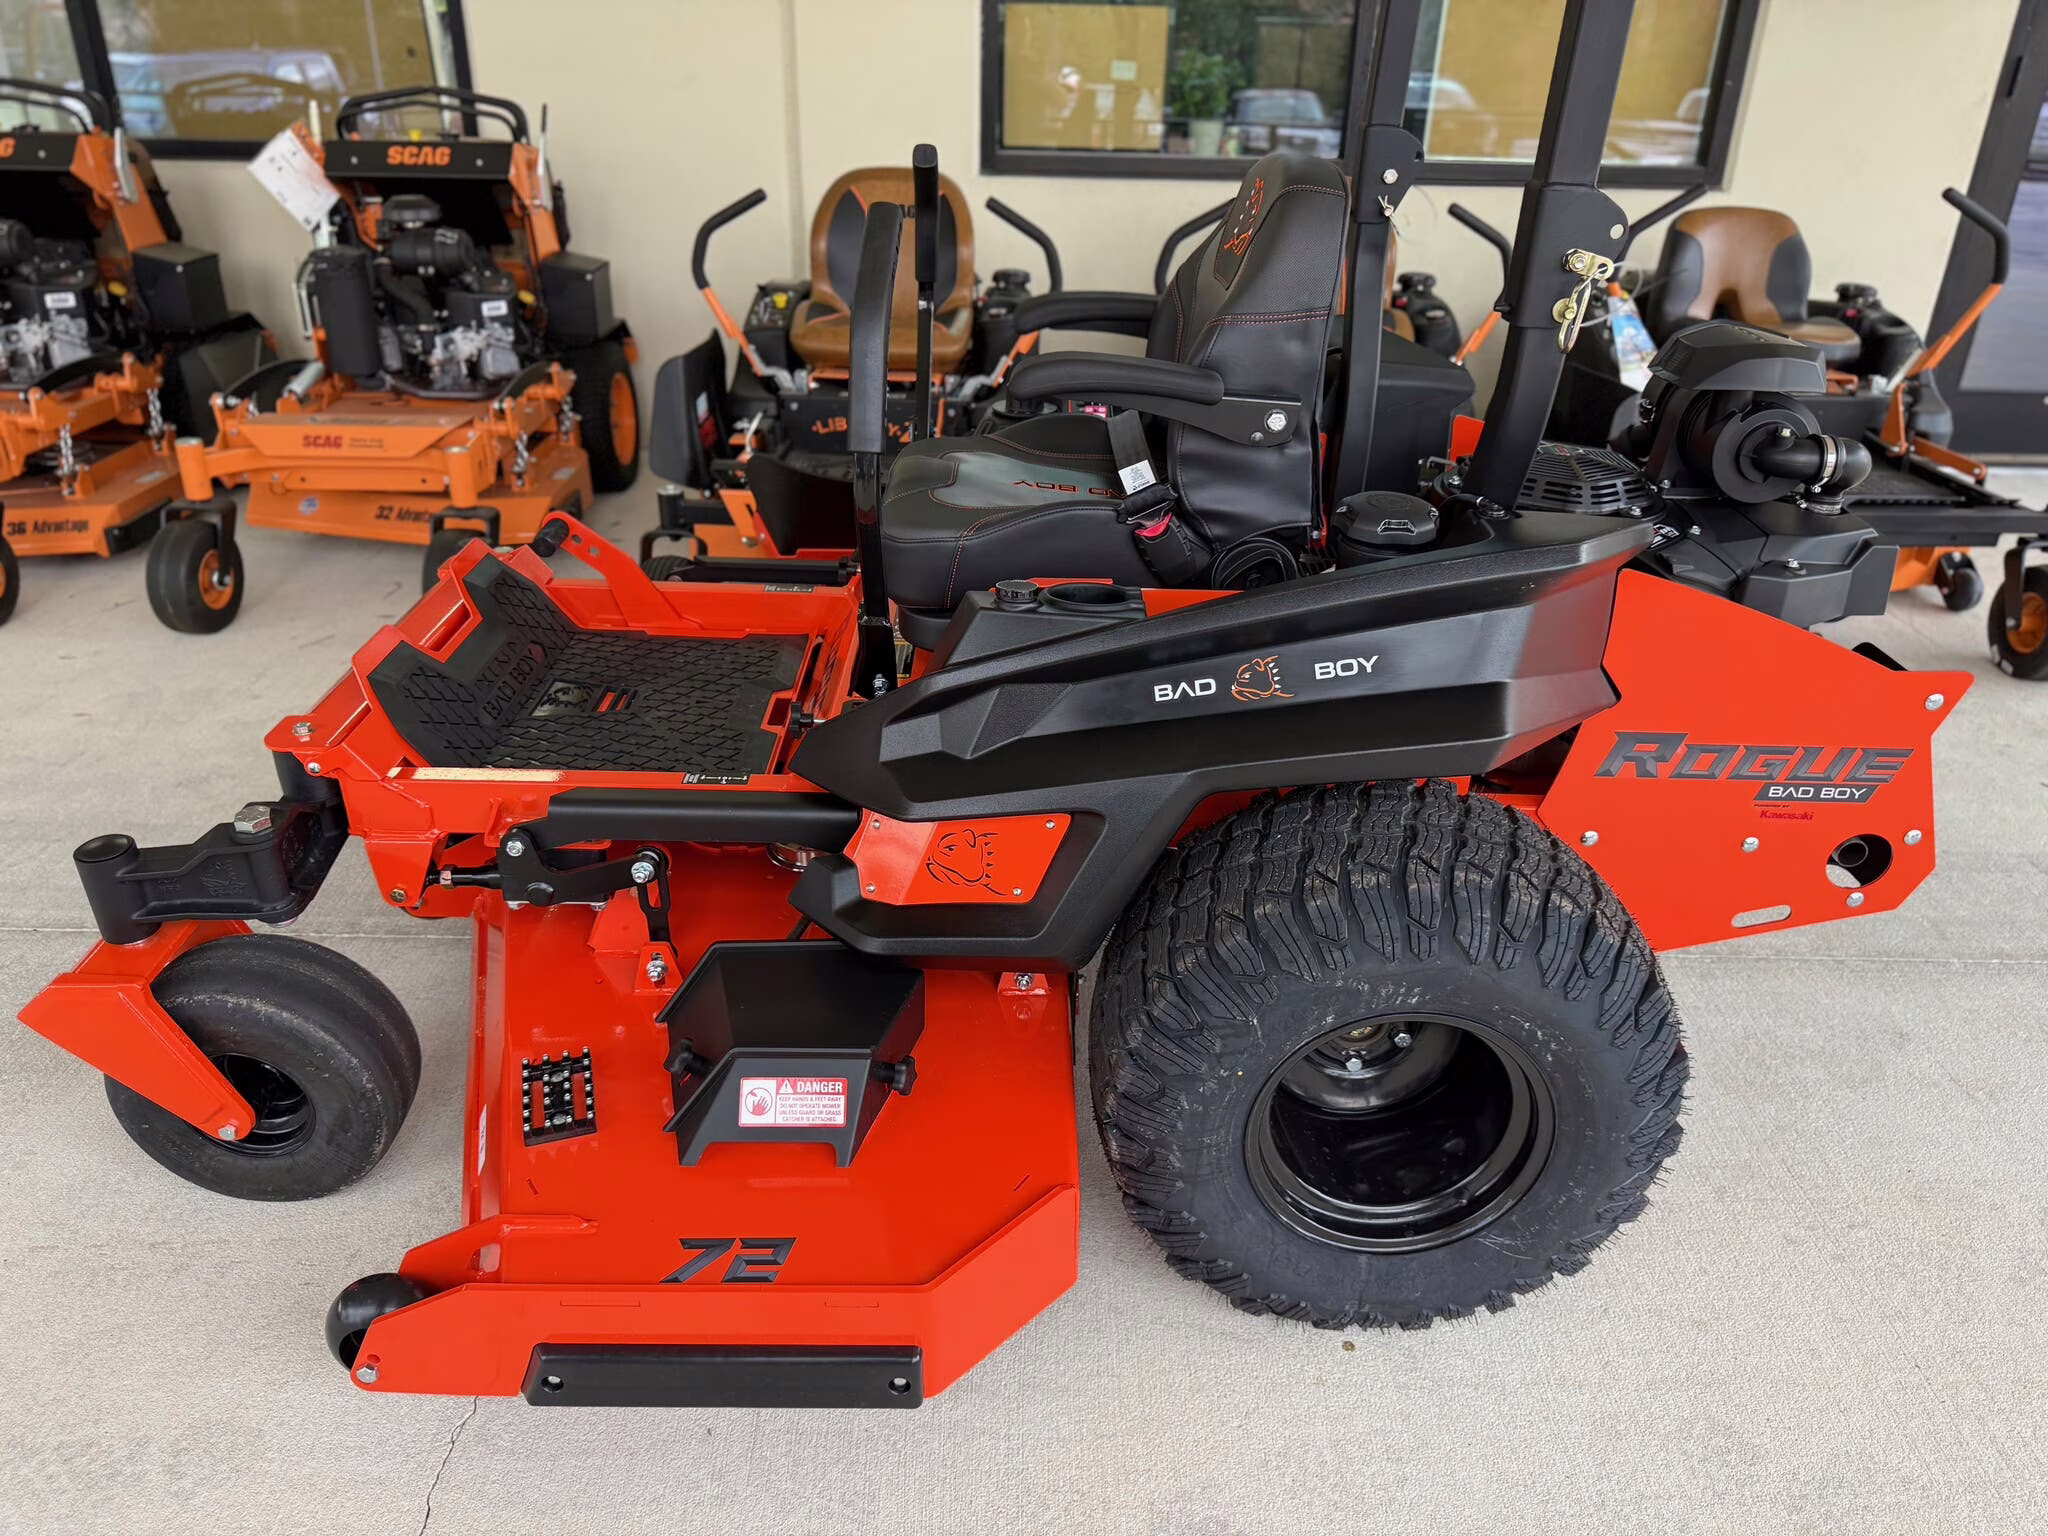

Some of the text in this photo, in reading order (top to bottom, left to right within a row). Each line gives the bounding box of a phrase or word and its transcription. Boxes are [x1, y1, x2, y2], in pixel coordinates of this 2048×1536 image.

[387, 145, 452, 166] SCAG
[302, 434, 343, 449] SCAG
[376, 505, 394, 520] 32
[8, 521, 26, 536] 36
[1154, 655, 1379, 702] BAD BOY
[1594, 731, 1914, 783] ROGUE
[1768, 786, 1867, 799] BAD BOY
[1759, 810, 1814, 821] Kawasaki
[797, 1081, 842, 1094] DANGER
[659, 1237, 798, 1284] 72
